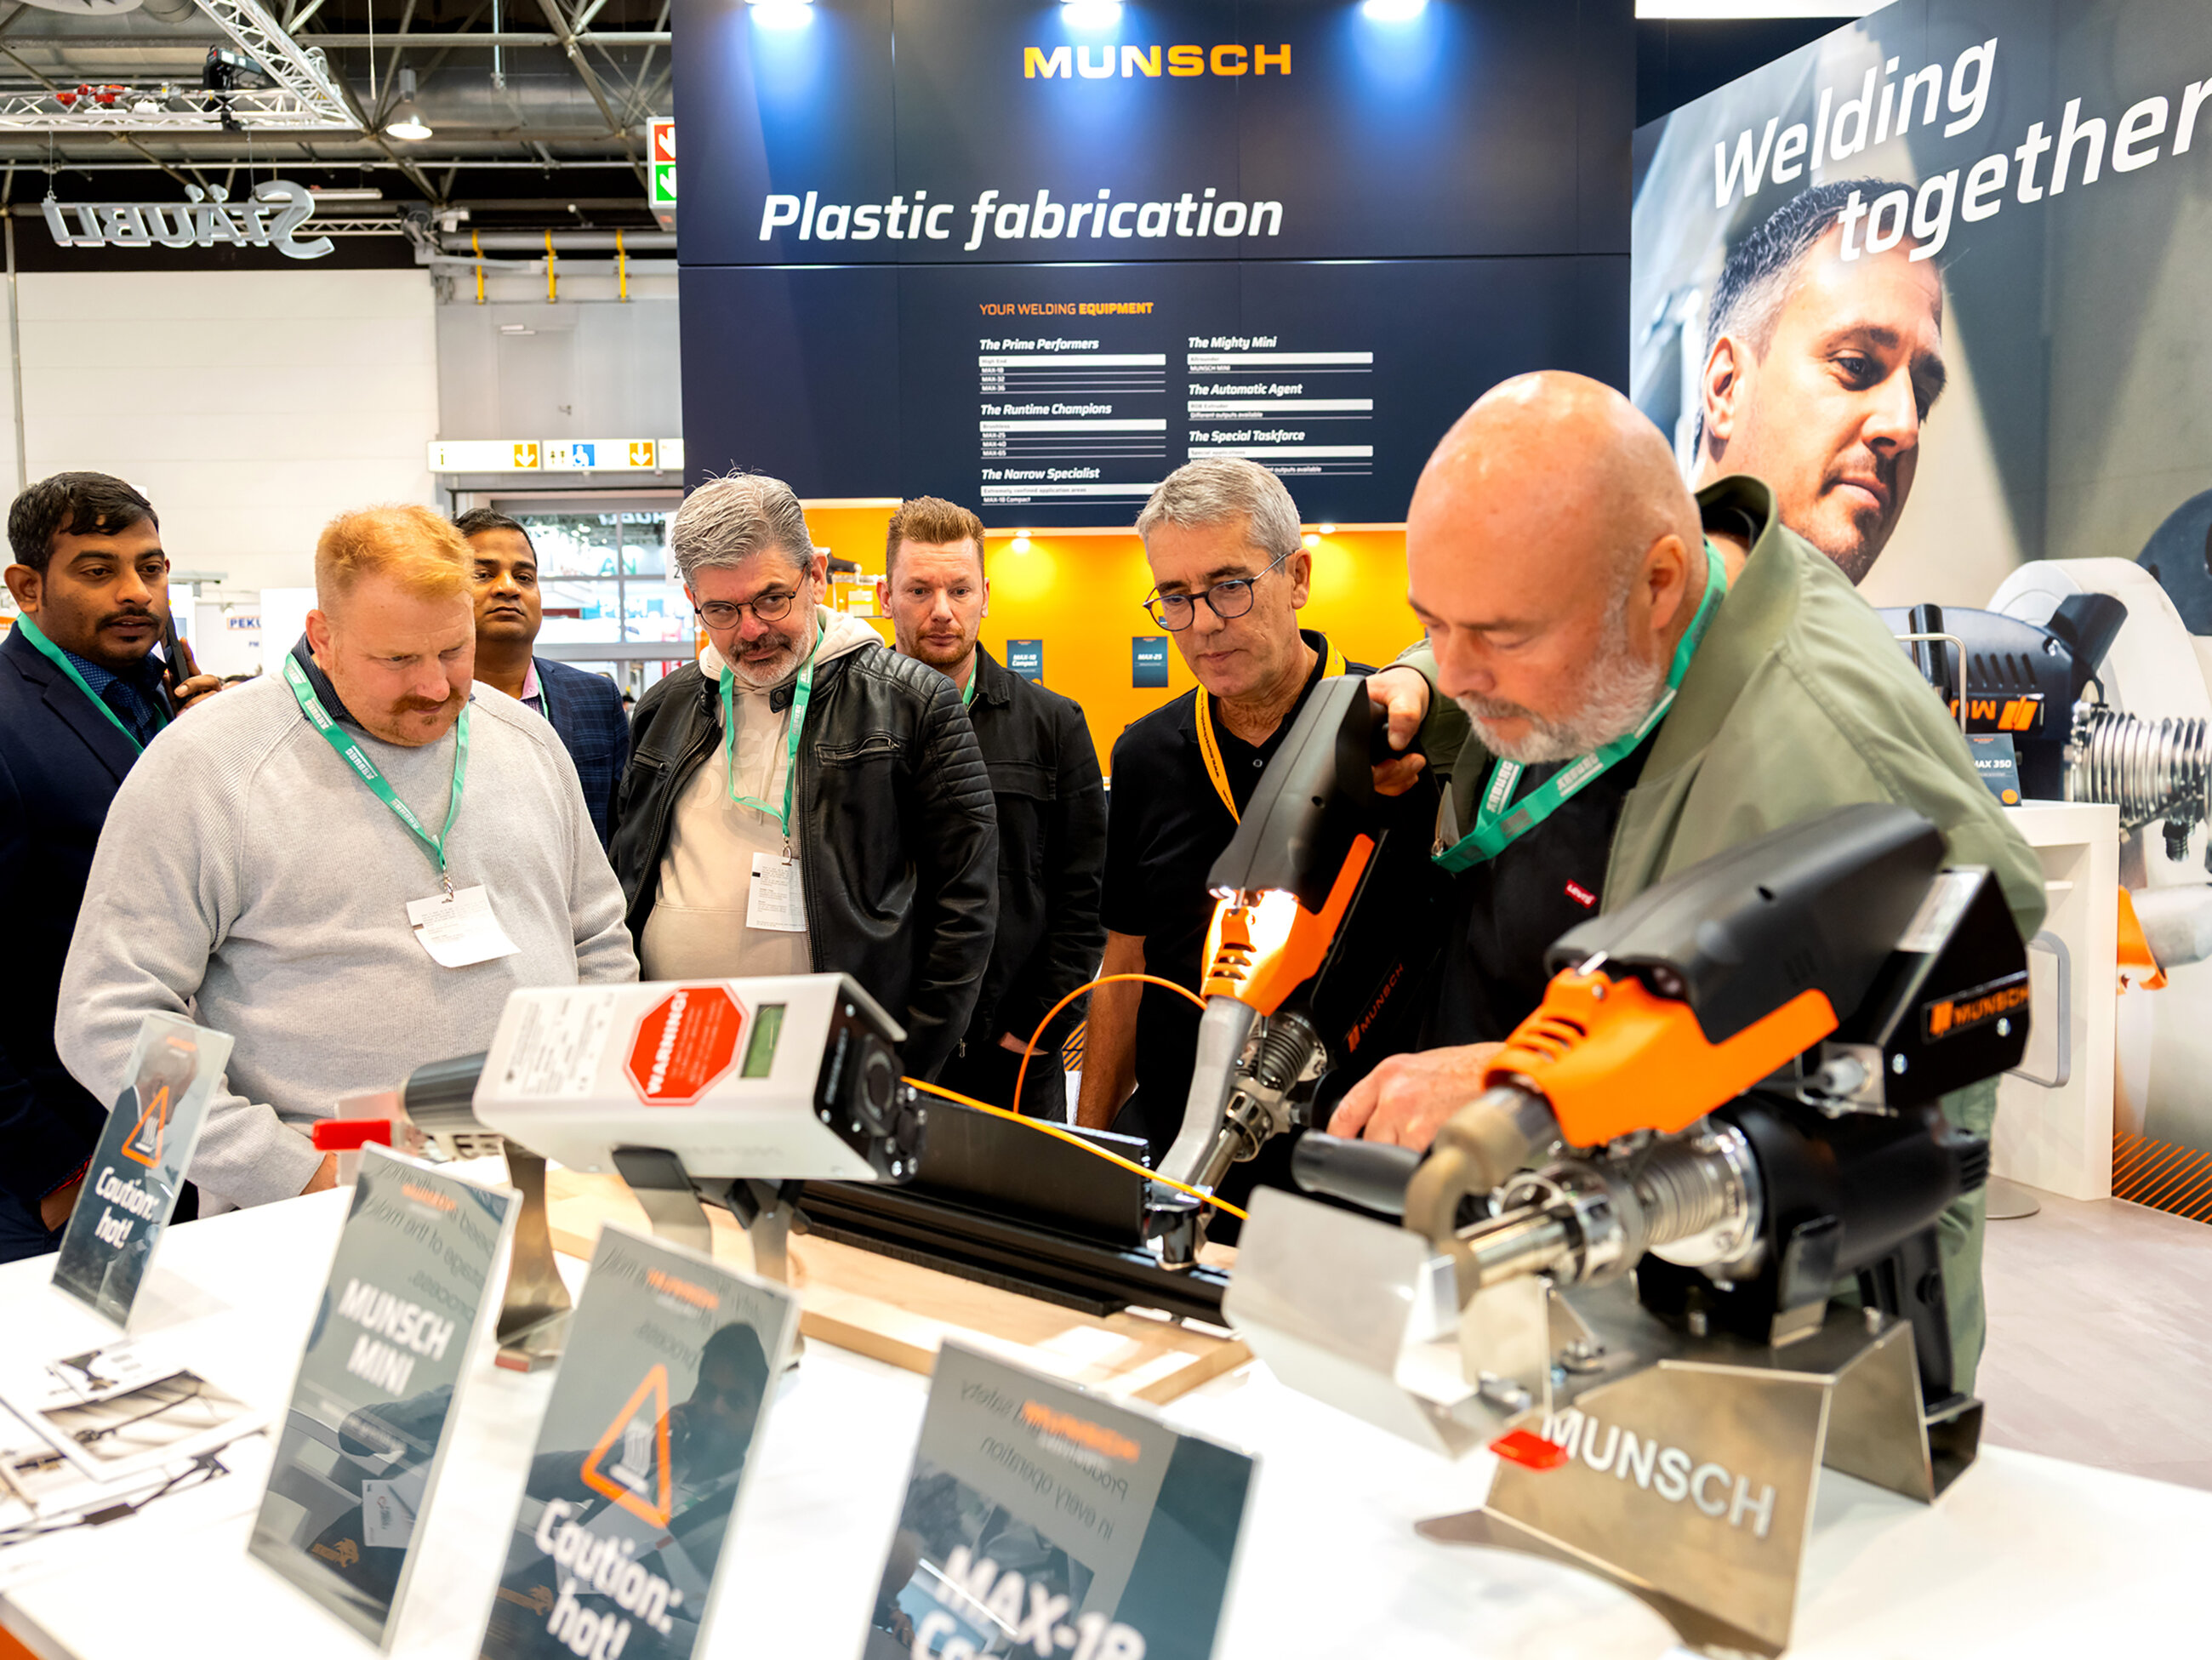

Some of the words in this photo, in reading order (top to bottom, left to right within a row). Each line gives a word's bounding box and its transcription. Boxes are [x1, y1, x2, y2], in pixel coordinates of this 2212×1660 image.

[1023, 43, 1292, 79] MUNSCH
[1713, 37, 1998, 208] Welding
[1837, 72, 2212, 263] together
[758, 190, 955, 241] Plastic
[963, 188, 1285, 251] fabrication
[979, 303, 1016, 316] YOUR
[1018, 302, 1077, 316] WELDING
[1078, 301, 1154, 316] EQUIPMENT
[980, 339, 1001, 351] The
[1002, 338, 1035, 351] Prime
[1037, 337, 1100, 352] Performers
[1189, 337, 1209, 349] The
[1211, 336, 1251, 351] Mighty
[1251, 335, 1278, 349] Mini
[981, 404, 1001, 416] The
[1002, 403, 1051, 416] Runtime
[1052, 402, 1113, 417] Champions
[1189, 384, 1210, 396] The
[1210, 382, 1268, 396] Automatic
[1268, 382, 1303, 397] Agent
[1189, 430, 1210, 442] The
[1211, 429, 1251, 444] Special
[1252, 429, 1306, 444] Taskforce
[981, 469, 1002, 481] The
[1004, 468, 1046, 481] Narrow
[1046, 466, 1101, 482] Specialist
[1993, 758, 2012, 769] 350
[1360, 962, 1405, 1034] MUNSCH
[647, 990, 690, 1096] WARNING!
[94, 1166, 161, 1222] Caution:
[94, 1205, 135, 1250] hot!
[338, 1275, 456, 1362] MUNSCH
[345, 1332, 417, 1397] MINI
[1540, 1407, 1777, 1538] MUNSCH
[534, 1497, 684, 1634] Caution:
[545, 1576, 633, 1660] hot!
